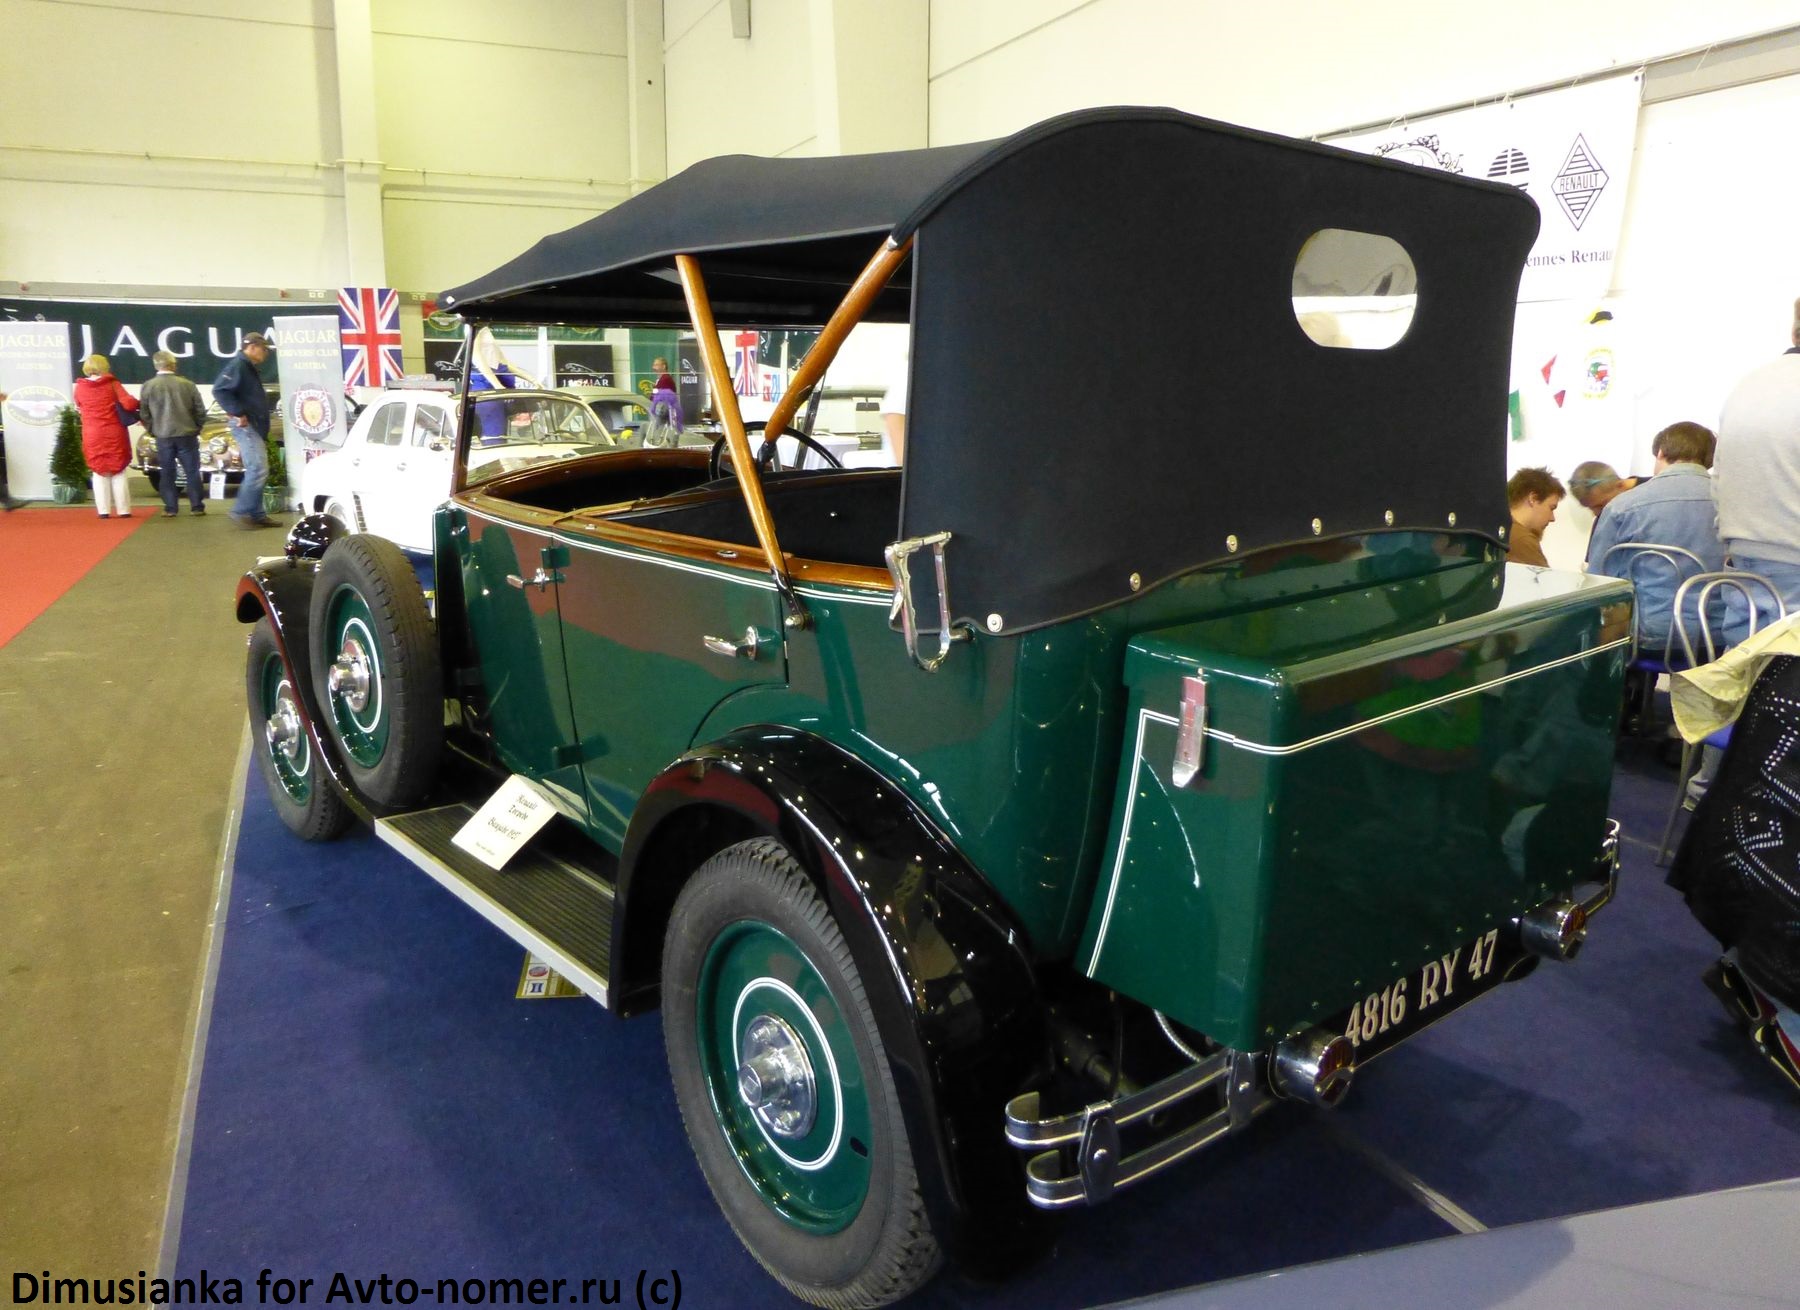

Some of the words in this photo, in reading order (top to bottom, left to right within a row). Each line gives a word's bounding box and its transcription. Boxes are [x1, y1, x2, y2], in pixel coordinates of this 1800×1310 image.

[1560, 173, 1599, 192] RENAULT
[1527, 254, 1566, 267] ennes
[1572, 249, 1613, 263] Renau
[0, 334, 66, 349] JAGUAR
[279, 330, 337, 346] JAGUAR
[681, 375, 698, 384] JAGUAR
[1345, 977, 1408, 1047] 4816
[1418, 947, 1462, 1010] RY
[1468, 928, 1498, 980] 47
